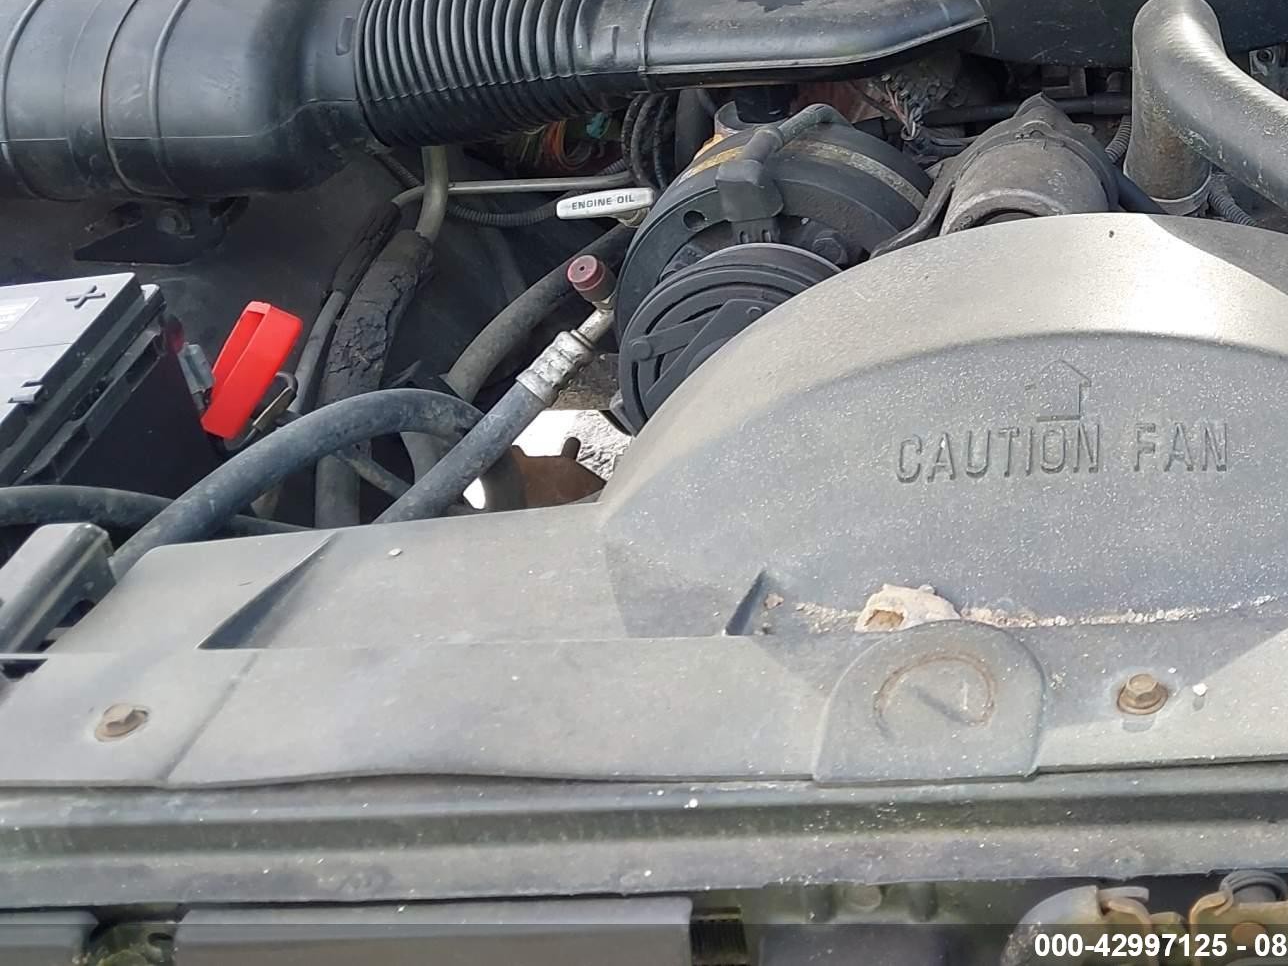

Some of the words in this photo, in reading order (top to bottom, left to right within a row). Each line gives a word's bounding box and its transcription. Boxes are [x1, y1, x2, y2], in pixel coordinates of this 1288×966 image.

[571, 197, 613, 210] ENGINE
[616, 194, 635, 204] OIL
[896, 422, 1100, 484] CAUTION
[1133, 421, 1229, 473] FAN
